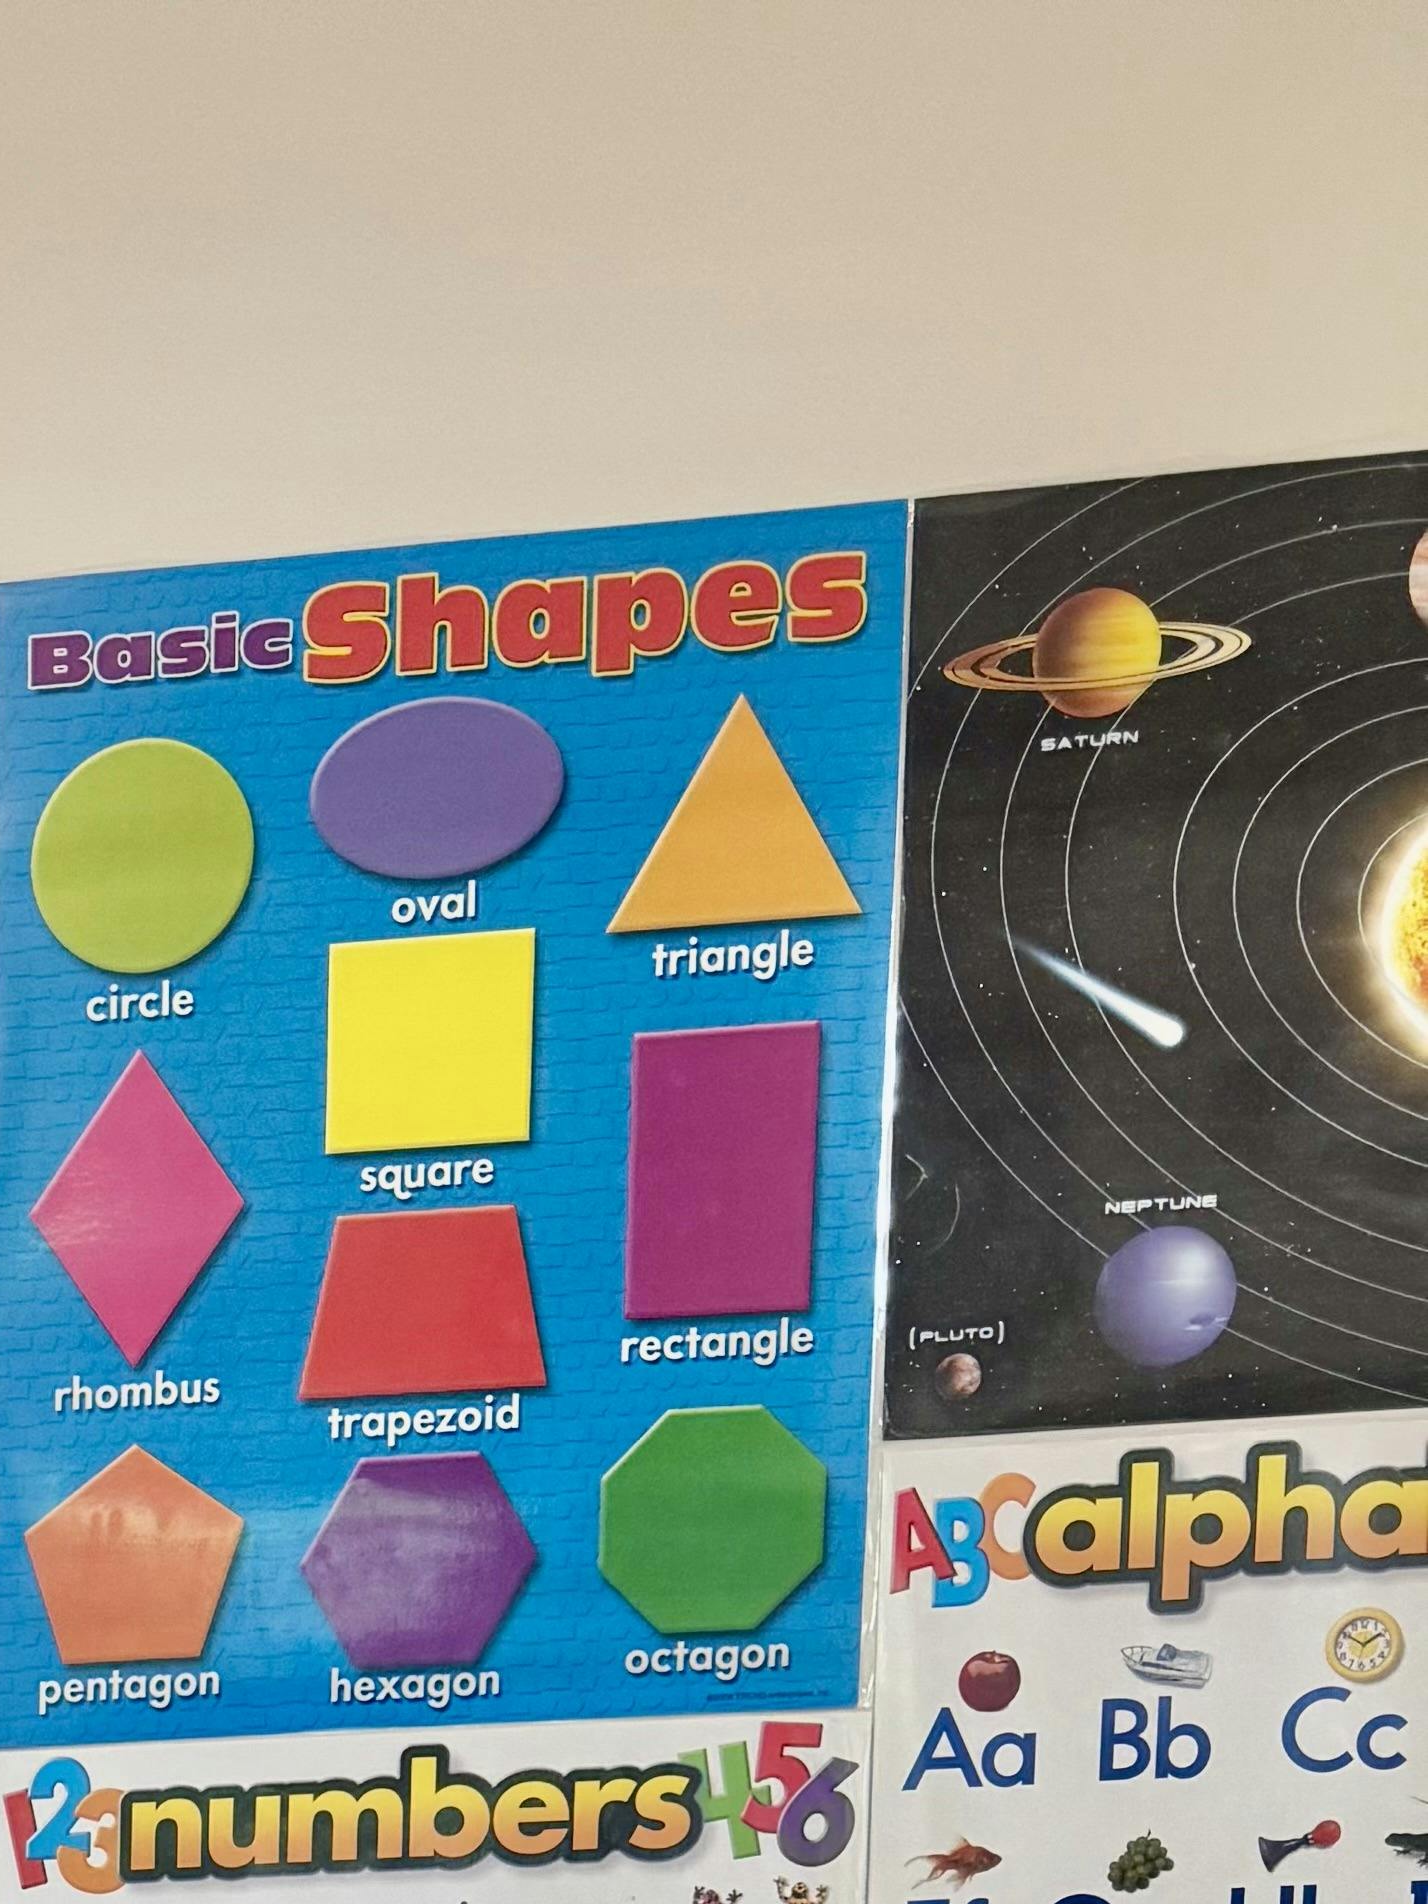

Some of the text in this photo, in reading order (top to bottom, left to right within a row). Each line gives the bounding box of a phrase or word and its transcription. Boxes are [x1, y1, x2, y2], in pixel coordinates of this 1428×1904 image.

[27, 551, 867, 691] Basic Shapes
[1040, 730, 1139, 752] SATURN
[391, 881, 476, 925] oval
[652, 930, 815, 982] triangle
[85, 981, 195, 1026] circle
[360, 1157, 494, 1201] square
[1105, 1194, 1218, 1215] NEPTUNE
[620, 1318, 815, 1370] rectangle
[909, 1320, 1005, 1350] (PLUTO)
[53, 1372, 221, 1414] rhombus
[328, 1395, 521, 1447] trapezoid
[890, 1472, 1037, 1607] ABC
[625, 1637, 791, 1681] octagon
[37, 1666, 221, 1714] pentagon
[329, 1666, 501, 1710] hexagon
[902, 1686, 1409, 1791] Aa Bb Cc
[3, 1721, 860, 1894] 123 numbers 456
